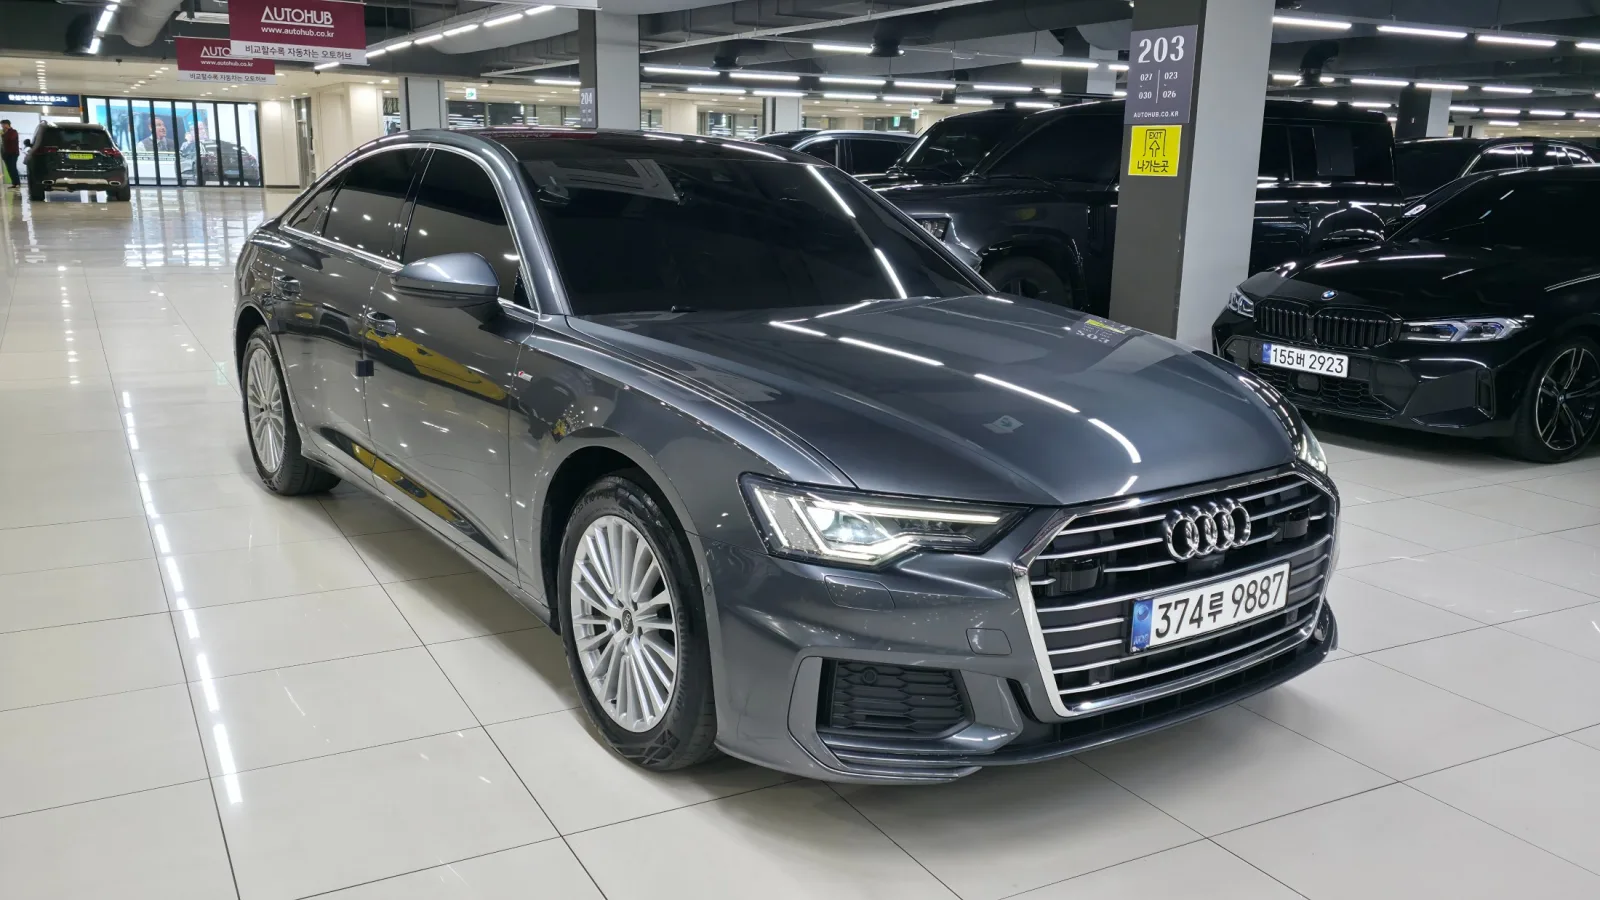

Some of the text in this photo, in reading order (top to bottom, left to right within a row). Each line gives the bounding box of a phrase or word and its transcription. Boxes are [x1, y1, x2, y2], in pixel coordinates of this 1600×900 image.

[261, 6, 334, 26] AUTOHUB
[261, 26, 334, 38] www.autohub.co.kr
[200, 46, 232, 57] AUTO
[245, 45, 352, 60] 비교할수록 자동차는 오토허브
[1138, 35, 1185, 63] 203
[1140, 71, 1178, 81] 027 023
[580, 92, 593, 105] 204
[1138, 90, 1177, 100] 030 026
[1133, 110, 1179, 118] AUTOHUB.CO.KR
[1149, 131, 1163, 140] EXIT
[1137, 160, 1169, 173] 나가는곳
[1272, 348, 1345, 374] 155버 2923
[1155, 570, 1285, 639] 374루 9887
